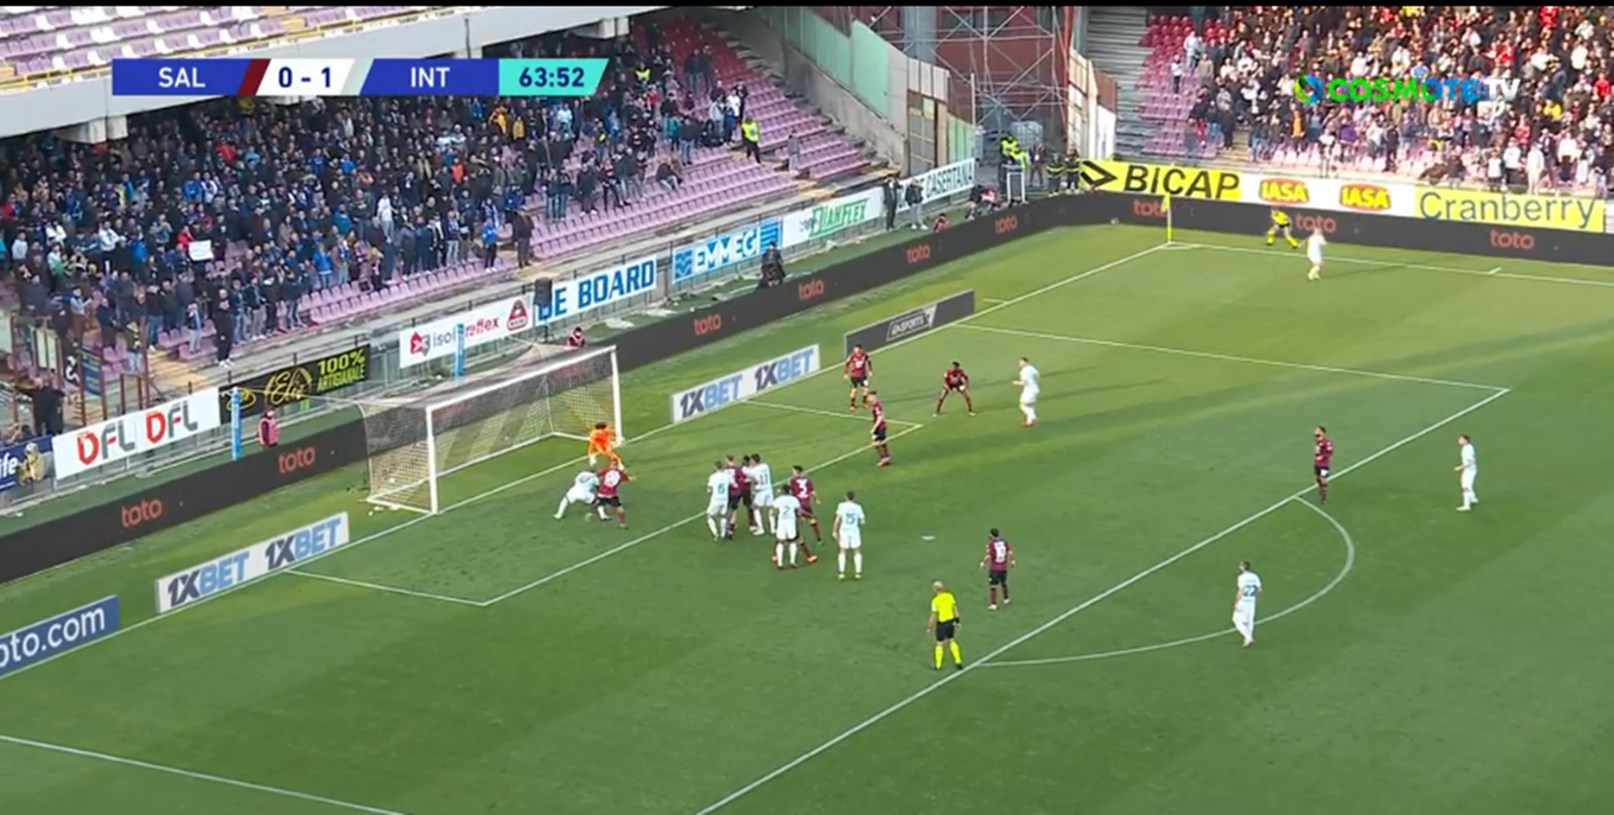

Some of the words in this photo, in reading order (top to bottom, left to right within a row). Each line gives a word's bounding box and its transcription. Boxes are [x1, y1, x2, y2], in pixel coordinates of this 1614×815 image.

[1123, 164, 1240, 200] BICAP
[1260, 180, 1308, 203] IASA
[1341, 185, 1390, 209] IASA
[1419, 191, 1596, 229] Cranberry
[1296, 213, 1337, 233] toto
[695, 227, 760, 268] EMMEGI
[906, 244, 930, 264] toto
[1489, 230, 1535, 250] toto
[578, 259, 655, 309] BOARD
[798, 279, 824, 299] toto
[694, 313, 722, 336] toto
[317, 348, 366, 374] 100%
[754, 349, 814, 391] 1XBET
[680, 375, 743, 418] 1XBET
[145, 400, 198, 444] DFL
[77, 420, 135, 465] DFL
[278, 446, 316, 475] toto
[796, 478, 808, 498] 3
[121, 499, 163, 528] toto
[265, 516, 341, 571] 1XBET
[167, 551, 250, 607] 1XBET
[1243, 584, 1259, 598] 22
